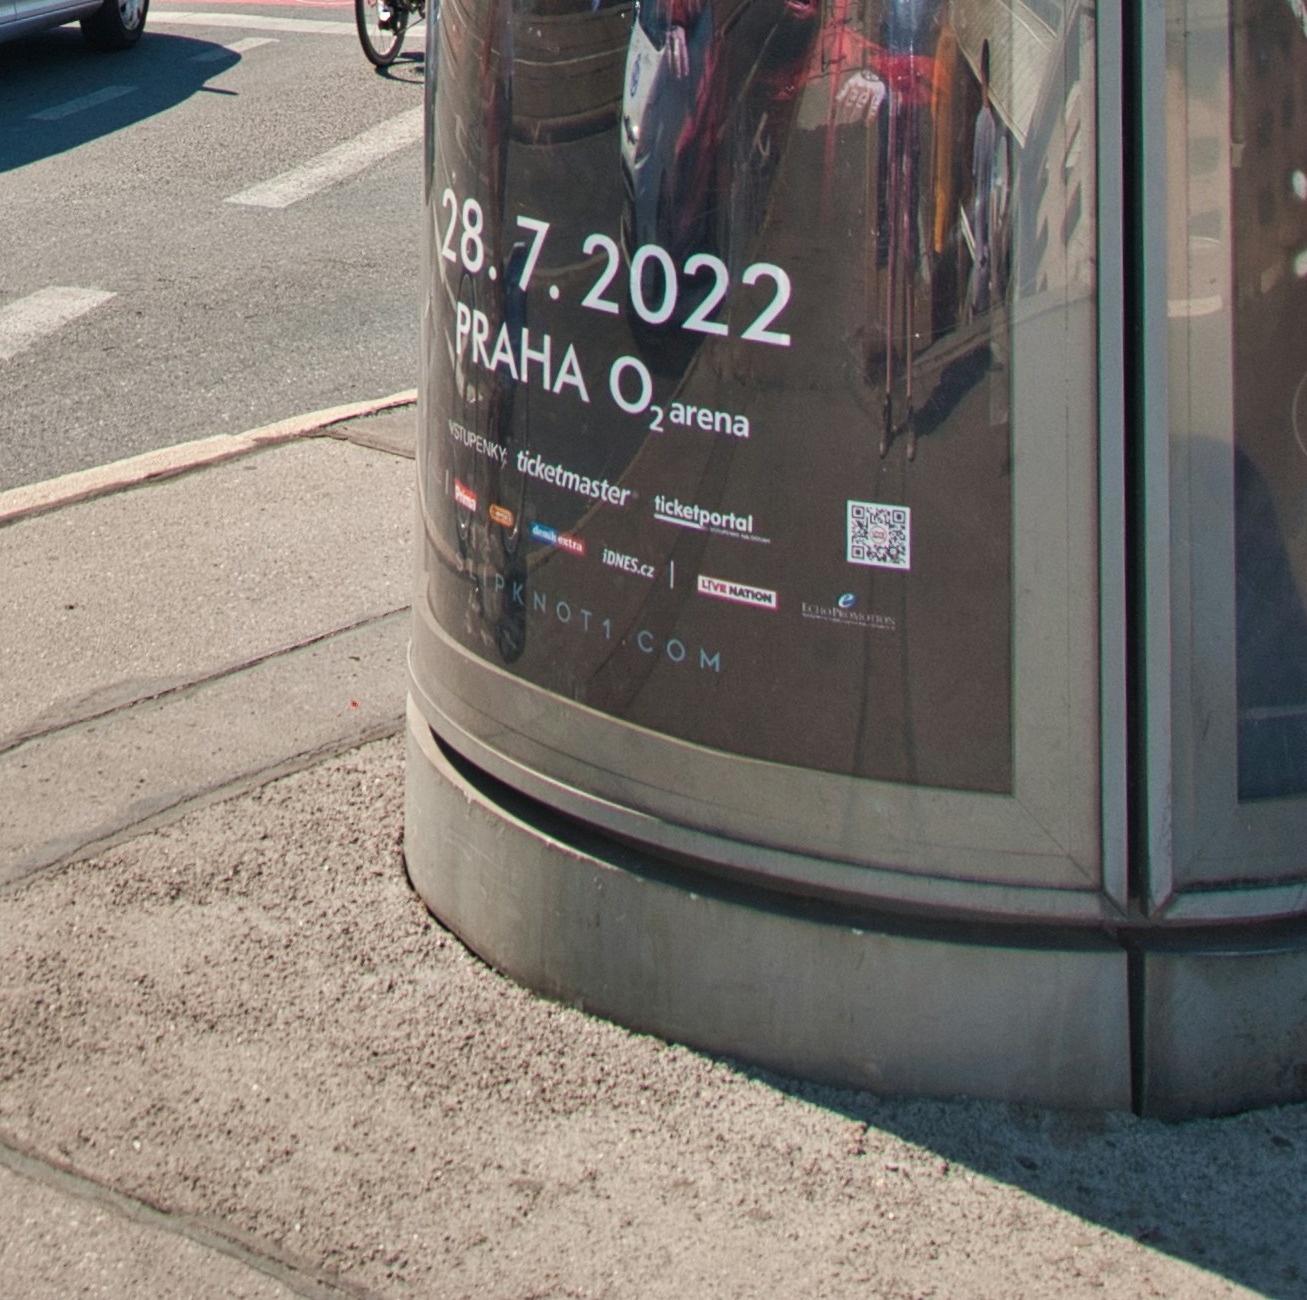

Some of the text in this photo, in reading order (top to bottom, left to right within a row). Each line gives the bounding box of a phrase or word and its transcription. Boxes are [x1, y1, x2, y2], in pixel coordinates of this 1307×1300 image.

[455, 301, 589, 403] PRAHA
[669, 402, 750, 438] arena
[517, 450, 631, 506] ticketmaster
[654, 495, 753, 533] ticketportal
[557, 531, 583, 551] extra
[602, 548, 655, 578] iDNES.cz
[701, 577, 772, 605] LIVE NATION
